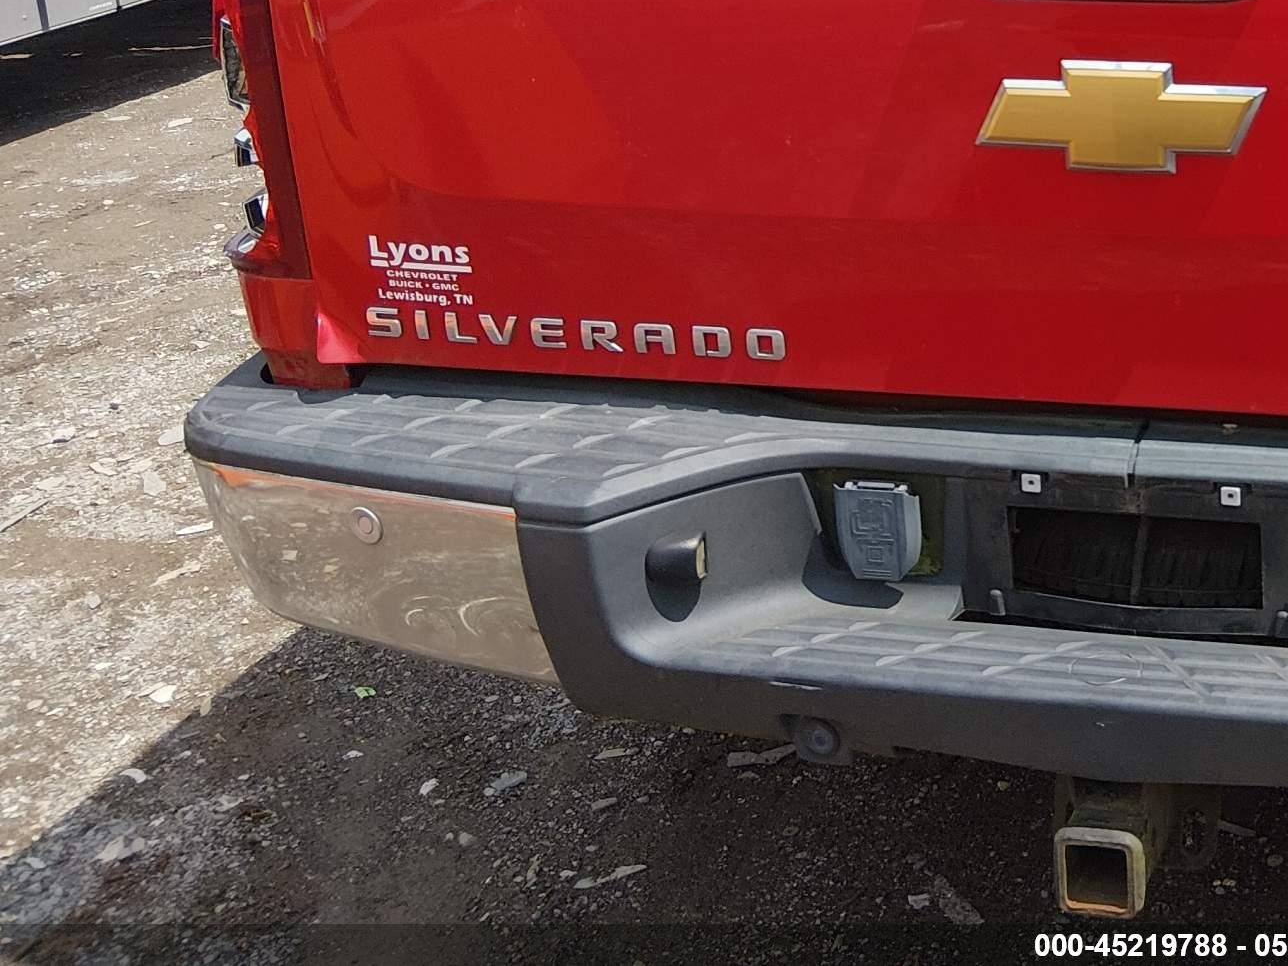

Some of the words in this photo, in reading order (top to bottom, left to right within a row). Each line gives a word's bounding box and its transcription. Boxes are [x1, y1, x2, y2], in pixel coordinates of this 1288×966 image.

[369, 234, 472, 267] Lyons
[386, 269, 459, 282] CHEVROLET
[388, 279, 423, 290] BUICK
[431, 281, 460, 292] GMC
[378, 287, 452, 307] Lewisburg,
[453, 293, 474, 306] TN
[365, 306, 788, 362] SILVERADO
